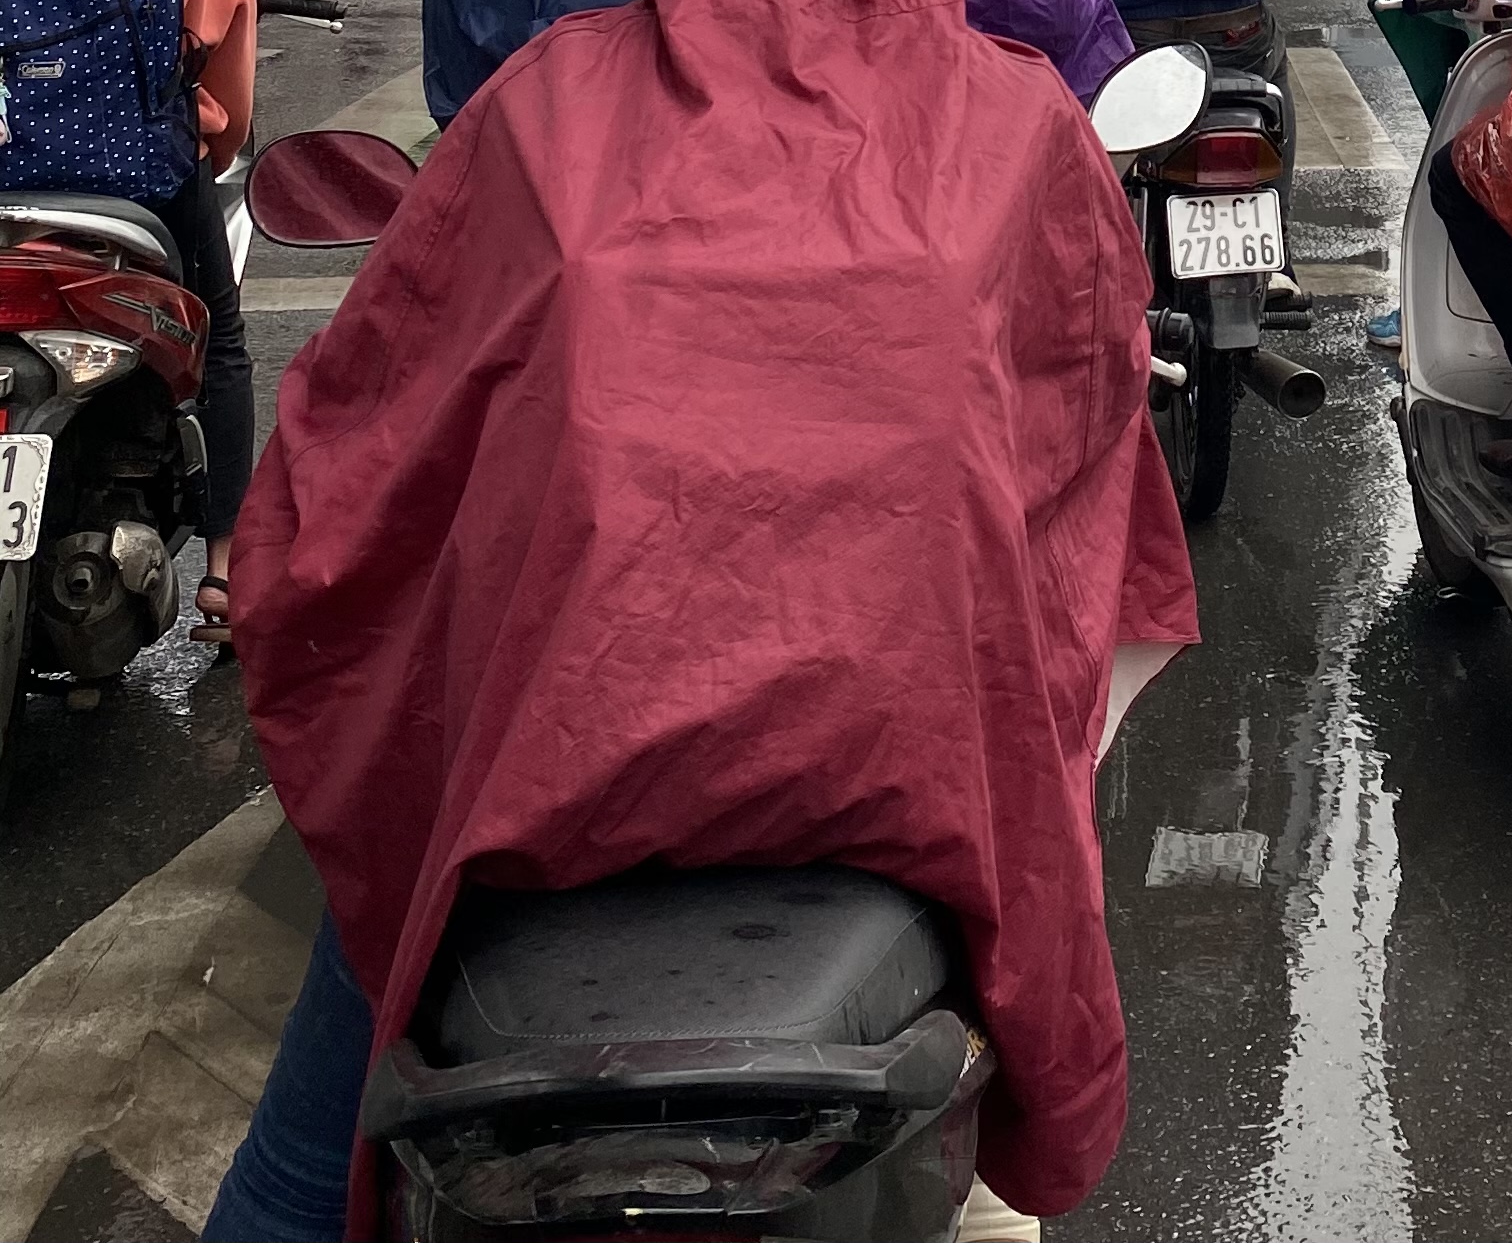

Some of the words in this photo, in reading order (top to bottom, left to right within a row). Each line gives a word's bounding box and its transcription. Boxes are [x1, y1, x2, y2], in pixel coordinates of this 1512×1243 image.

[1186, 196, 1260, 233] 29-C1
[1179, 233, 1275, 272] 278.66
[3, 446, 17, 492] 1
[3, 501, 27, 548] 3
